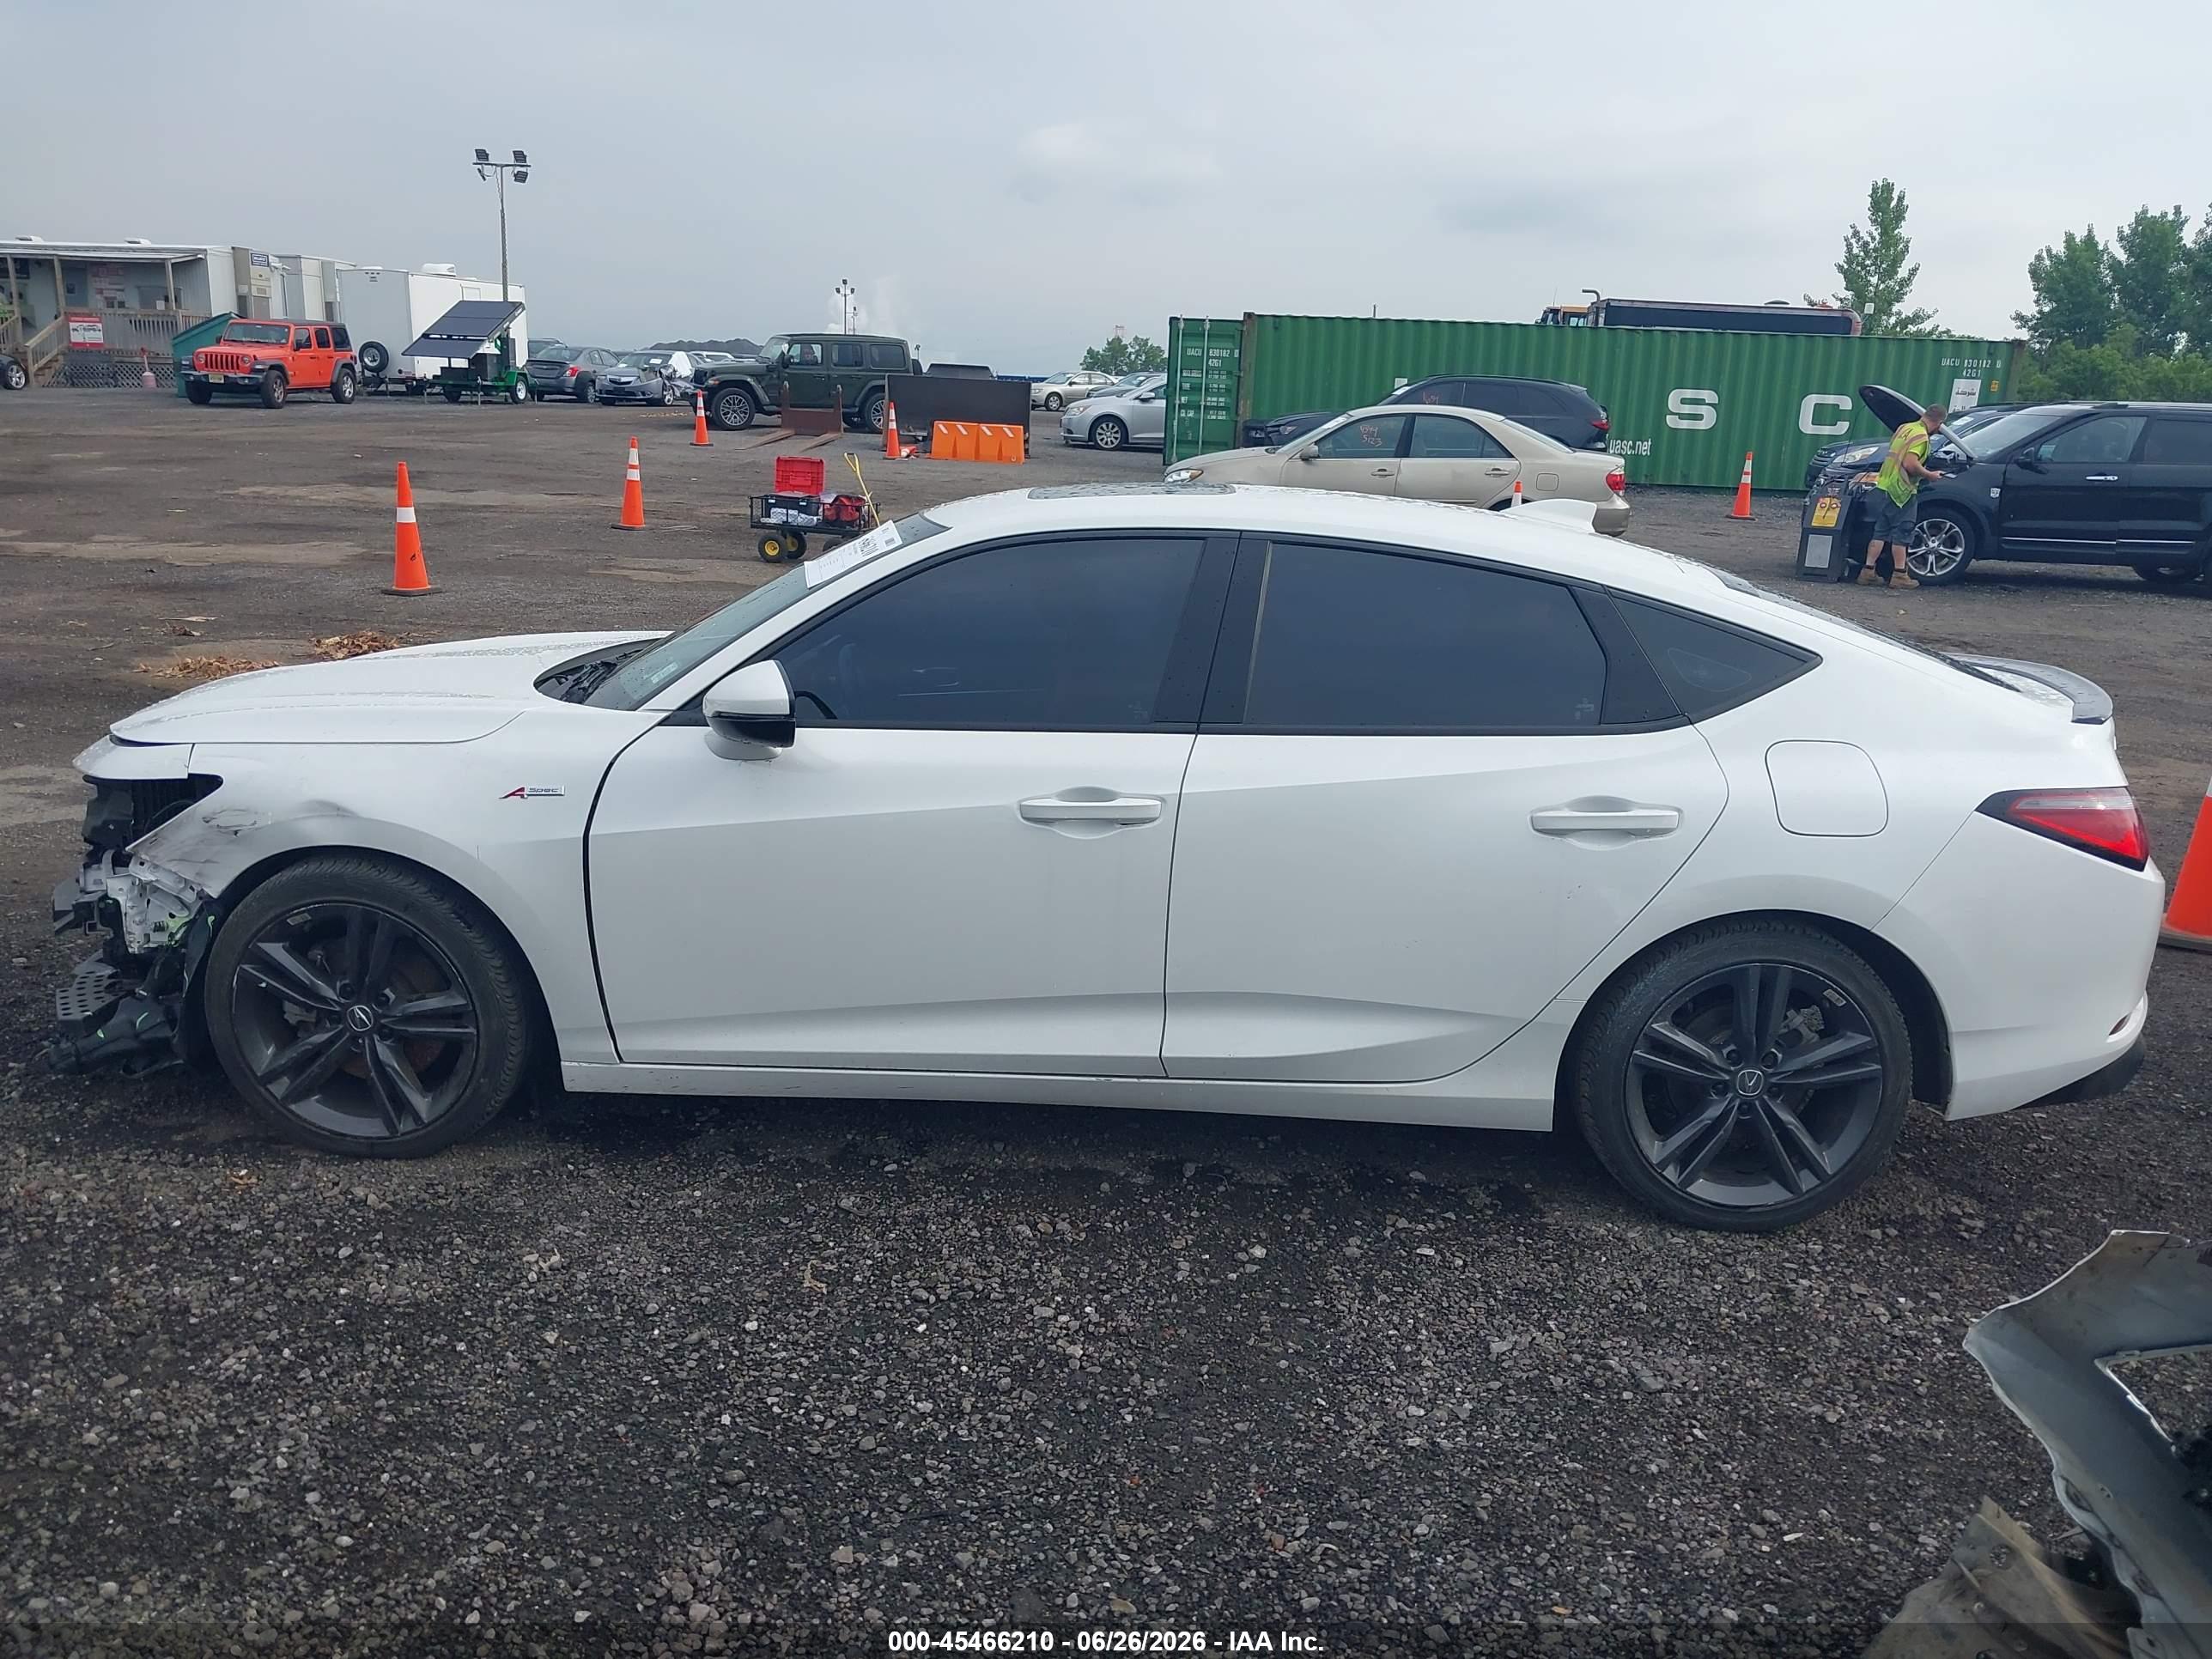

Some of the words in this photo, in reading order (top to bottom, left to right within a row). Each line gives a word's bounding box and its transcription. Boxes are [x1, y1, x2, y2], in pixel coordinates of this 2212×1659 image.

[1187, 348, 1202, 356] UACU
[1209, 349, 1230, 357] 830182
[1208, 359, 1221, 368] 42G1
[1942, 357, 1960, 367] UACU
[1964, 359, 1991, 368] 830182
[1963, 368, 1981, 377] 42G1
[1666, 388, 1718, 429] S
[1799, 393, 1852, 435] C
[1609, 438, 1651, 456] uasc.net
